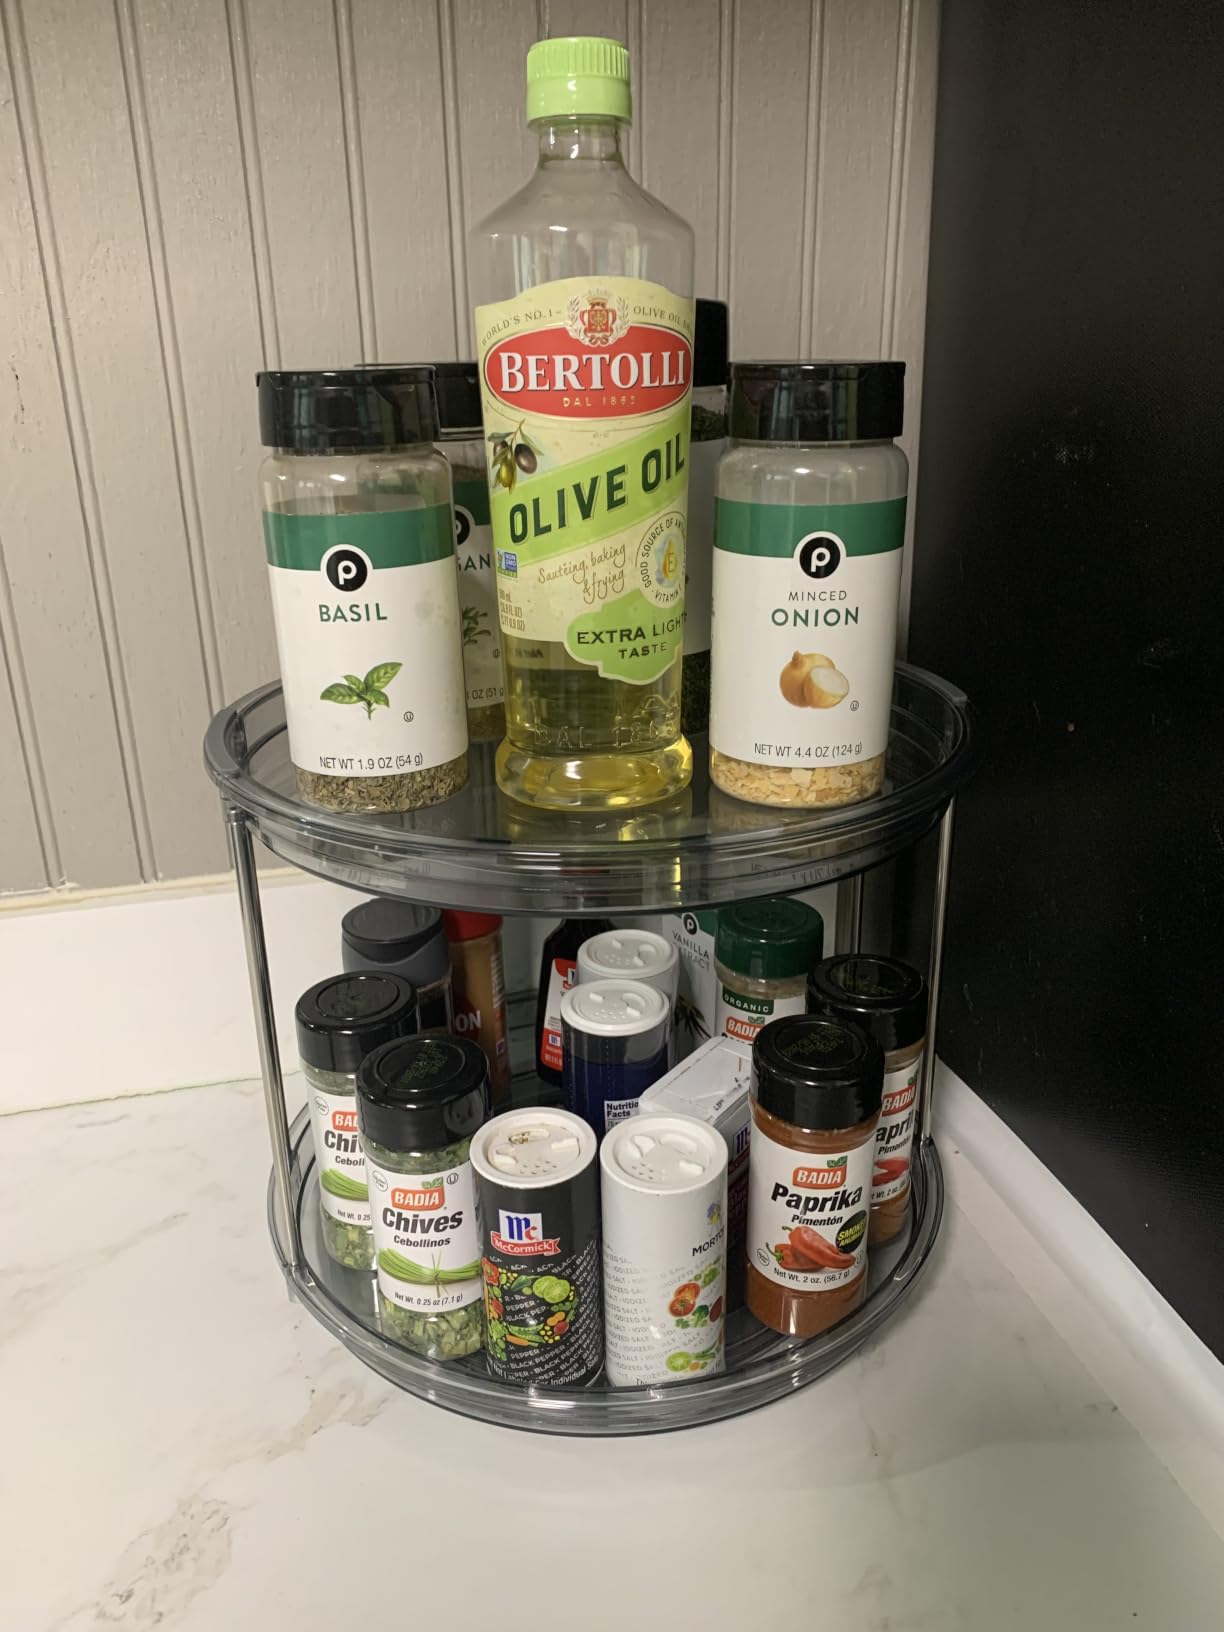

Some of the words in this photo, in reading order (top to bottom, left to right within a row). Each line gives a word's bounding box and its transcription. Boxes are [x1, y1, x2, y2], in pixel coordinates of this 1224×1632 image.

[525, 310, 546, 322] NO.
[634, 306, 665, 320] OLIVE
[499, 350, 686, 393] BERTOLLI
[563, 397, 591, 408] DAL
[509, 463, 626, 544] OLIVE
[641, 433, 685, 493] OIL
[642, 522, 664, 558] SOURCE
[591, 544, 626, 568] baking
[640, 561, 652, 588] GOOD
[583, 579, 591, 597] &
[584, 569, 625, 604] frying
[788, 590, 848, 602] MINCED
[319, 603, 388, 622] BASIL
[771, 606, 860, 627] ONION
[577, 626, 646, 644] EXTRA
[618, 642, 667, 659] TASTE
[472, 689, 483, 700] OZ
[754, 742, 774, 756] NET
[775, 745, 792, 757] WT
[794, 746, 812, 758] 4.4
[815, 745, 830, 757] OZ
[832, 743, 853, 757] (124
[320, 756, 337, 769] NET
[338, 758, 355, 770] WT
[357, 757, 375, 770] 1.9
[377, 756, 393, 769] OZ
[396, 755, 412, 768] (54
[413, 752, 423, 766] g)
[672, 930, 709, 959] VANILLA
[724, 994, 769, 1013] ORGANIC
[607, 1110, 631, 1118] Facts
[797, 1170, 842, 1185] BADIA
[395, 1191, 440, 1206] BADIA
[771, 1182, 862, 1216] Paprika
[382, 1207, 464, 1234] Chives
[791, 1214, 843, 1226] Pimentón
[393, 1235, 451, 1248] Cebollinos
[495, 1237, 552, 1253] McCormick
[774, 1267, 787, 1279] Net
[788, 1273, 800, 1283] Wt.
[394, 1292, 404, 1300] Net
[405, 1296, 415, 1304] Wt.
[417, 1298, 432, 1306] 0.25
[441, 1296, 454, 1307] (7.1
[506, 1300, 535, 1312] PEPPER
[510, 1361, 535, 1370] BLACK
[534, 1345, 566, 1364] PEPPER
[511, 1348, 540, 1360] PEPPER
[560, 1348, 583, 1370] BLACK
[534, 1358, 561, 1374] BLACK
[550, 1366, 587, 1386] Individual
